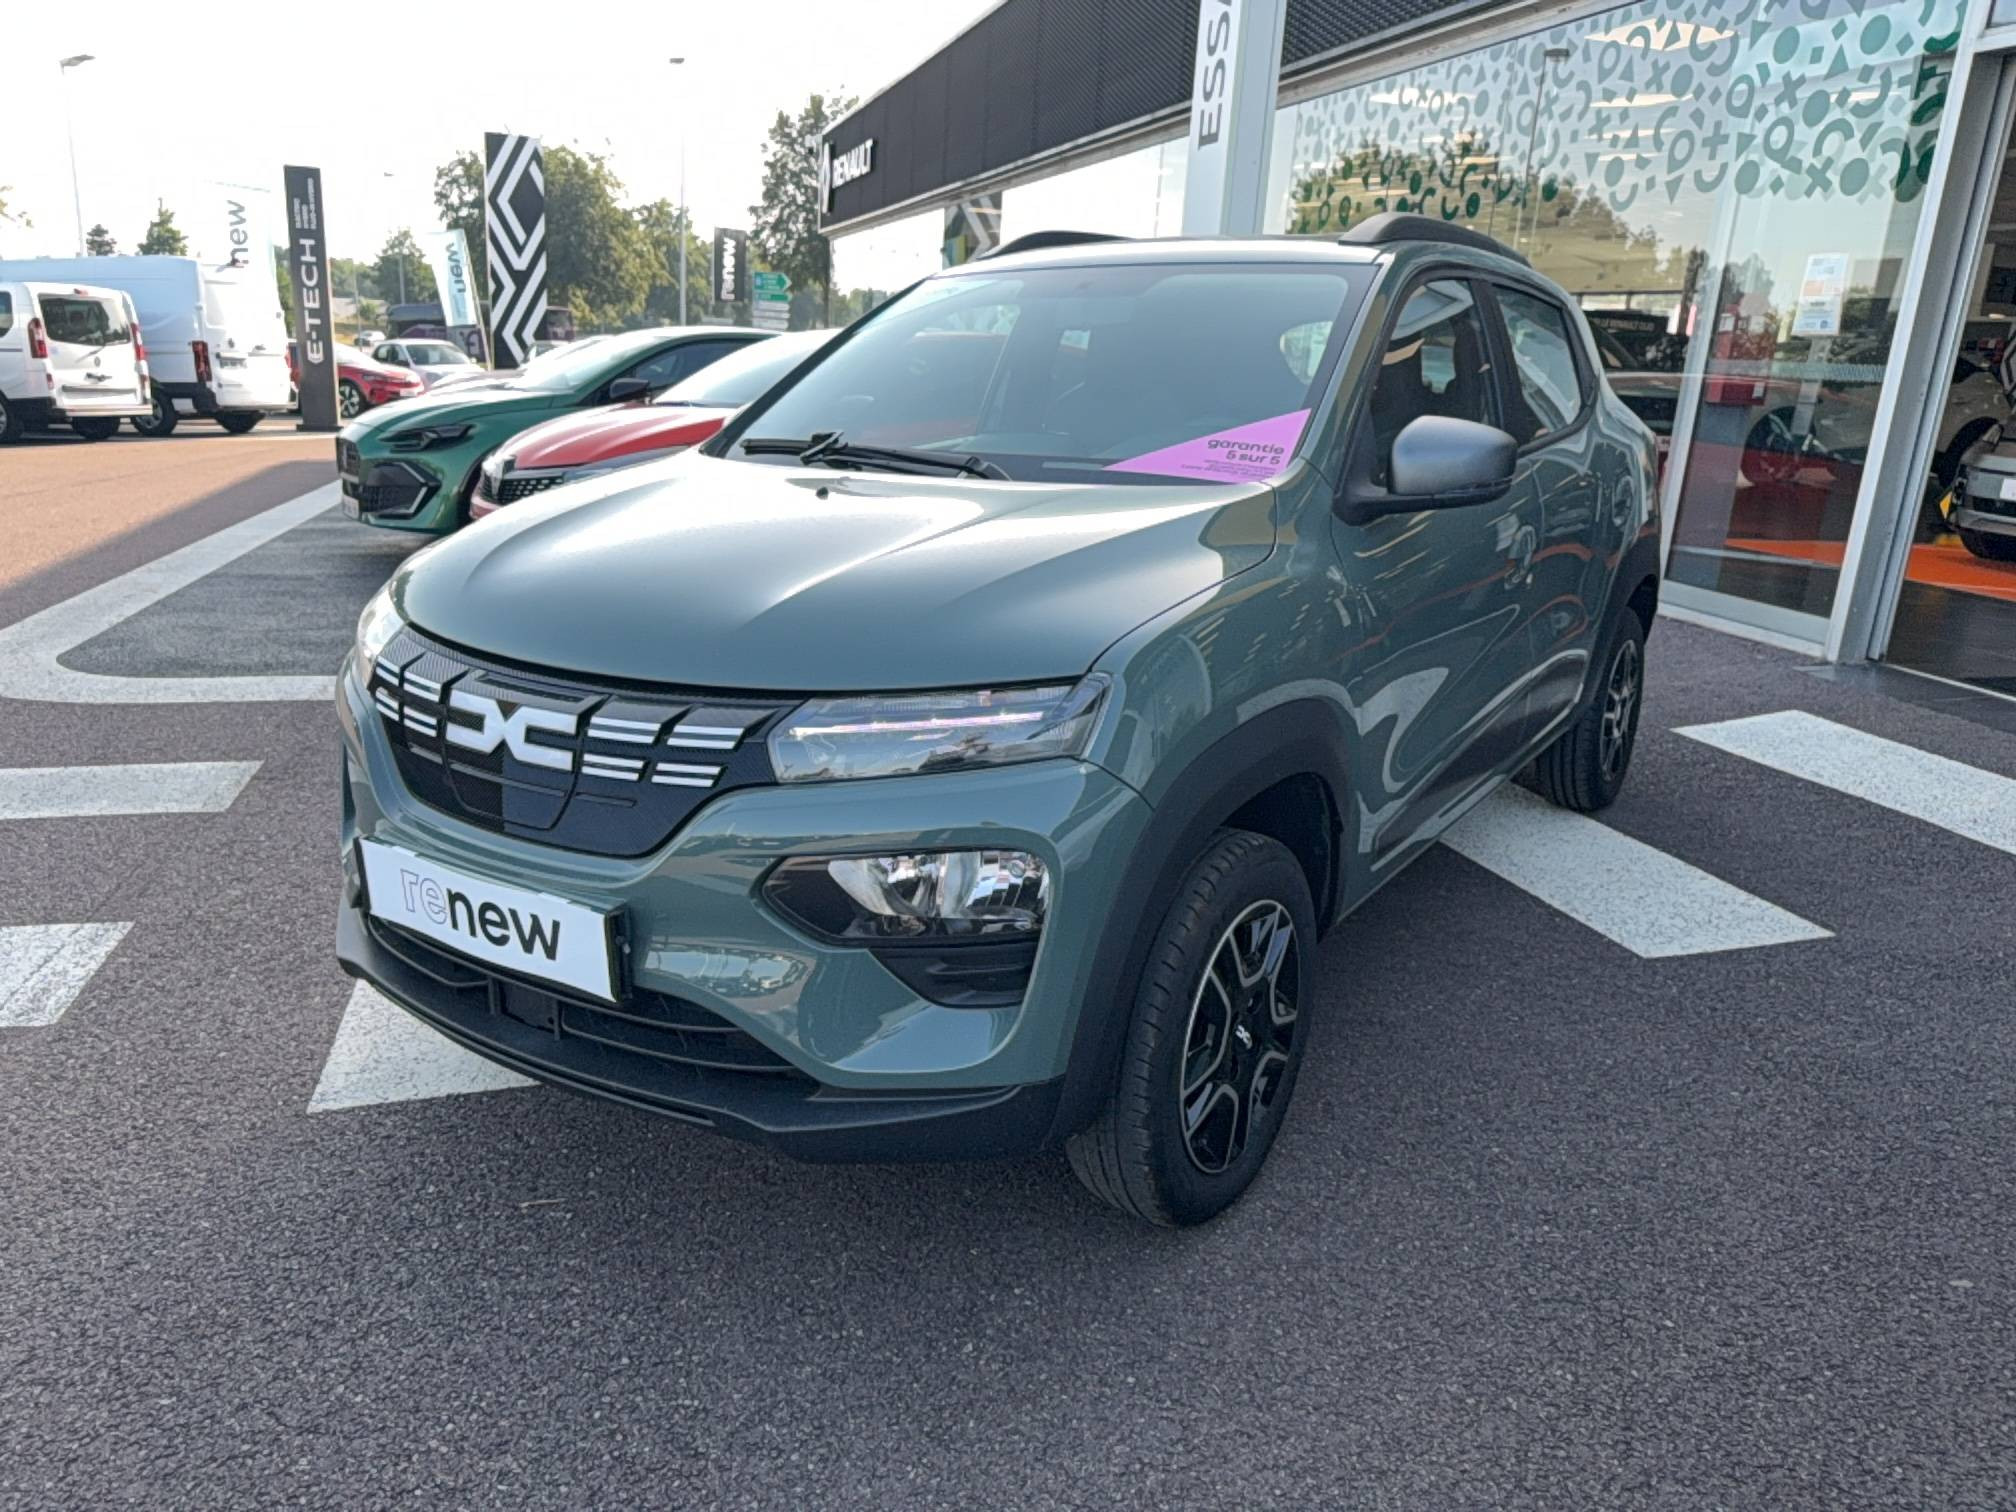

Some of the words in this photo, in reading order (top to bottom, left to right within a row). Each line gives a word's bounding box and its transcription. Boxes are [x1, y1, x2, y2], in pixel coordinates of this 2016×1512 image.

[1198, 0, 1232, 151] ESS
[832, 138, 873, 189] RENAULT
[721, 237, 736, 300] renew
[300, 238, 325, 363] E-TECH
[1208, 439, 1284, 454] garantie
[1227, 451, 1237, 460] 5
[1238, 453, 1266, 463] sur
[1270, 455, 1281, 465] 5
[400, 868, 561, 962] renew
